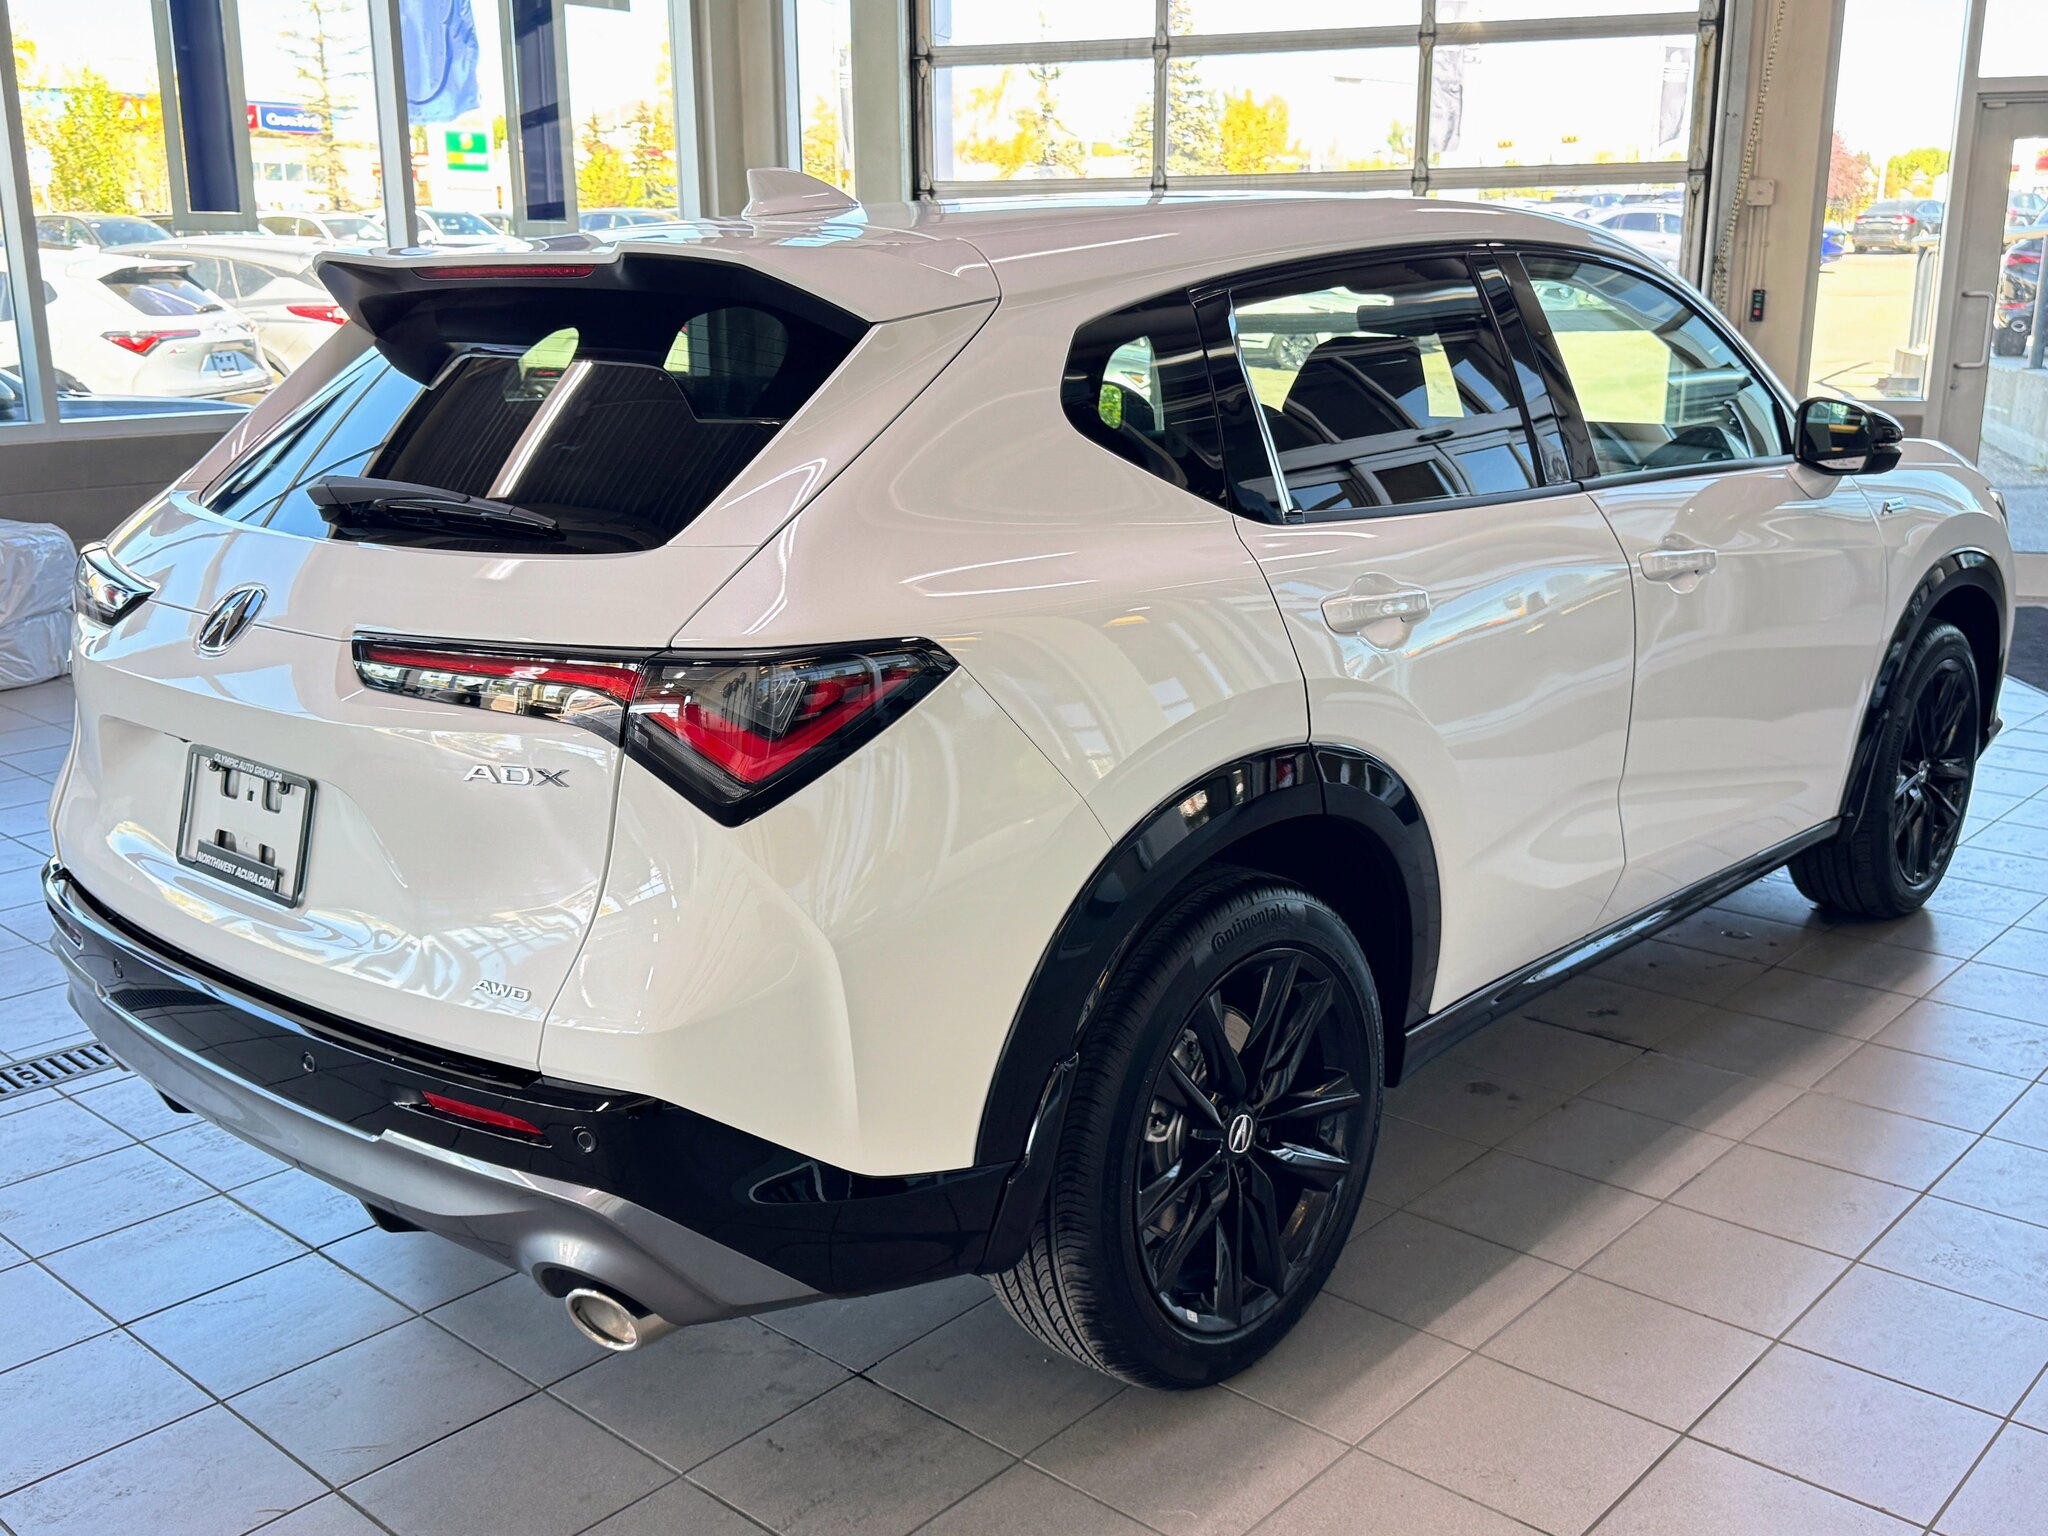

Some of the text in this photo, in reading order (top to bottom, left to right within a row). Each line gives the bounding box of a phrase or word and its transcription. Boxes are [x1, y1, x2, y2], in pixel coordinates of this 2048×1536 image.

[213, 752, 240, 768] OLYMPIC
[239, 760, 254, 773] AUTO
[463, 763, 570, 788] ADX
[196, 851, 276, 891] NORTHWEST ACURA.COM
[1211, 903, 1282, 954] Continental
[471, 979, 532, 1003] AWD
